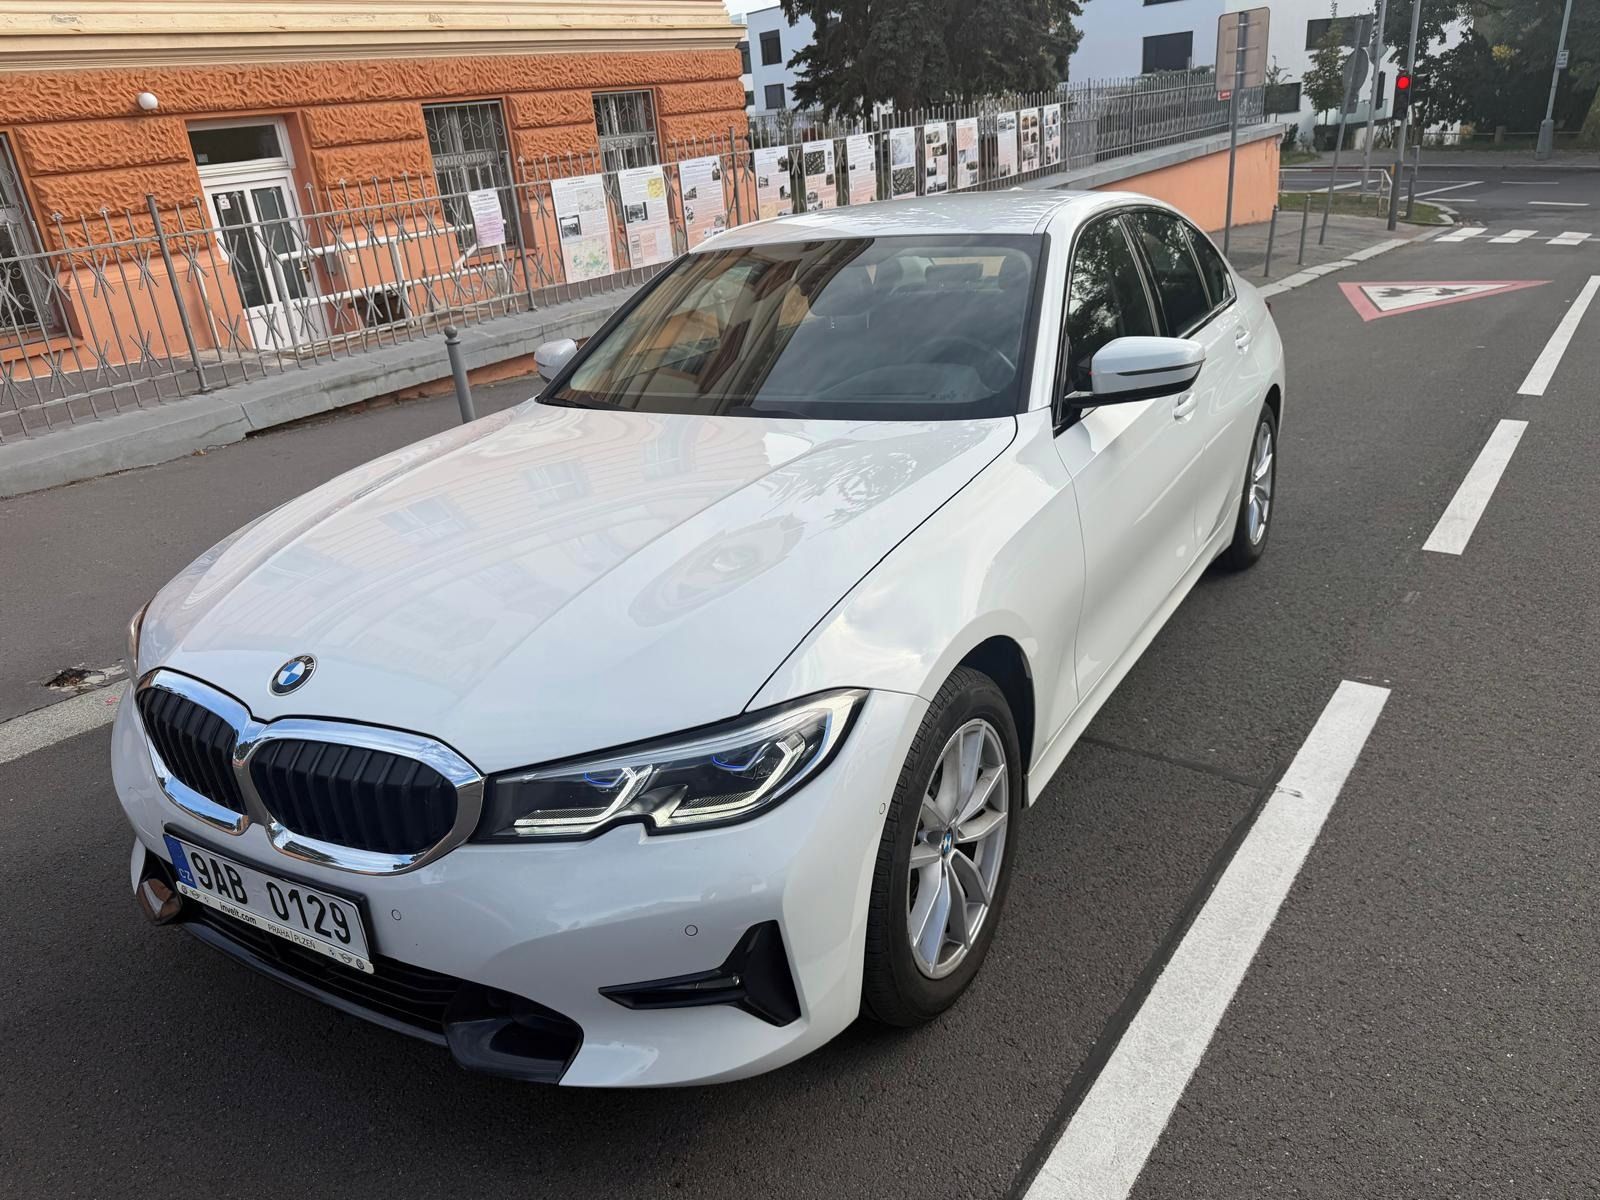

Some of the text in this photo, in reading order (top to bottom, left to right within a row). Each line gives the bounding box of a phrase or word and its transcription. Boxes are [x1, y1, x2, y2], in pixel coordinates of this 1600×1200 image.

[178, 868, 194, 882] CZ
[191, 852, 351, 945] 9AB 0129
